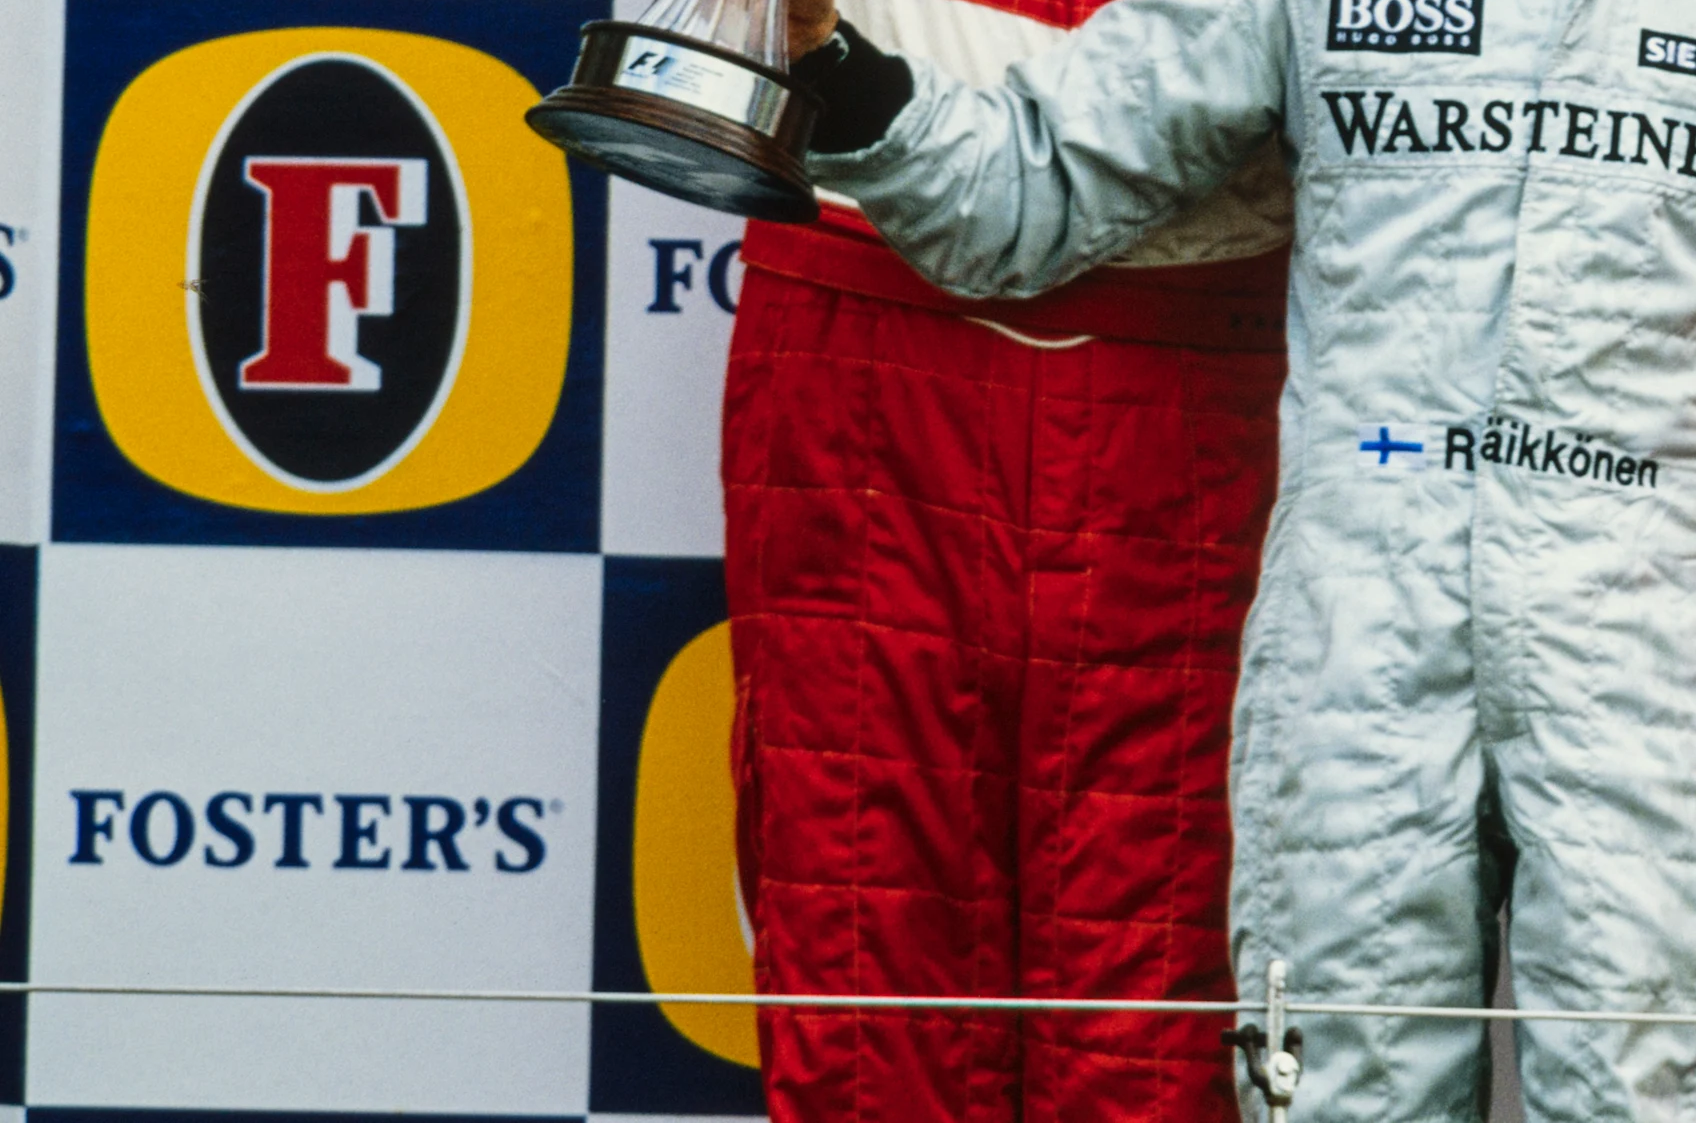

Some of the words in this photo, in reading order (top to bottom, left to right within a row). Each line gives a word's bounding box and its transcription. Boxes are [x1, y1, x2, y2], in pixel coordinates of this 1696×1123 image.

[1336, 30, 1398, 46] HUGO
[1443, 416, 1659, 488] Räikkönen
[68, 789, 547, 874] FOSTER'S
